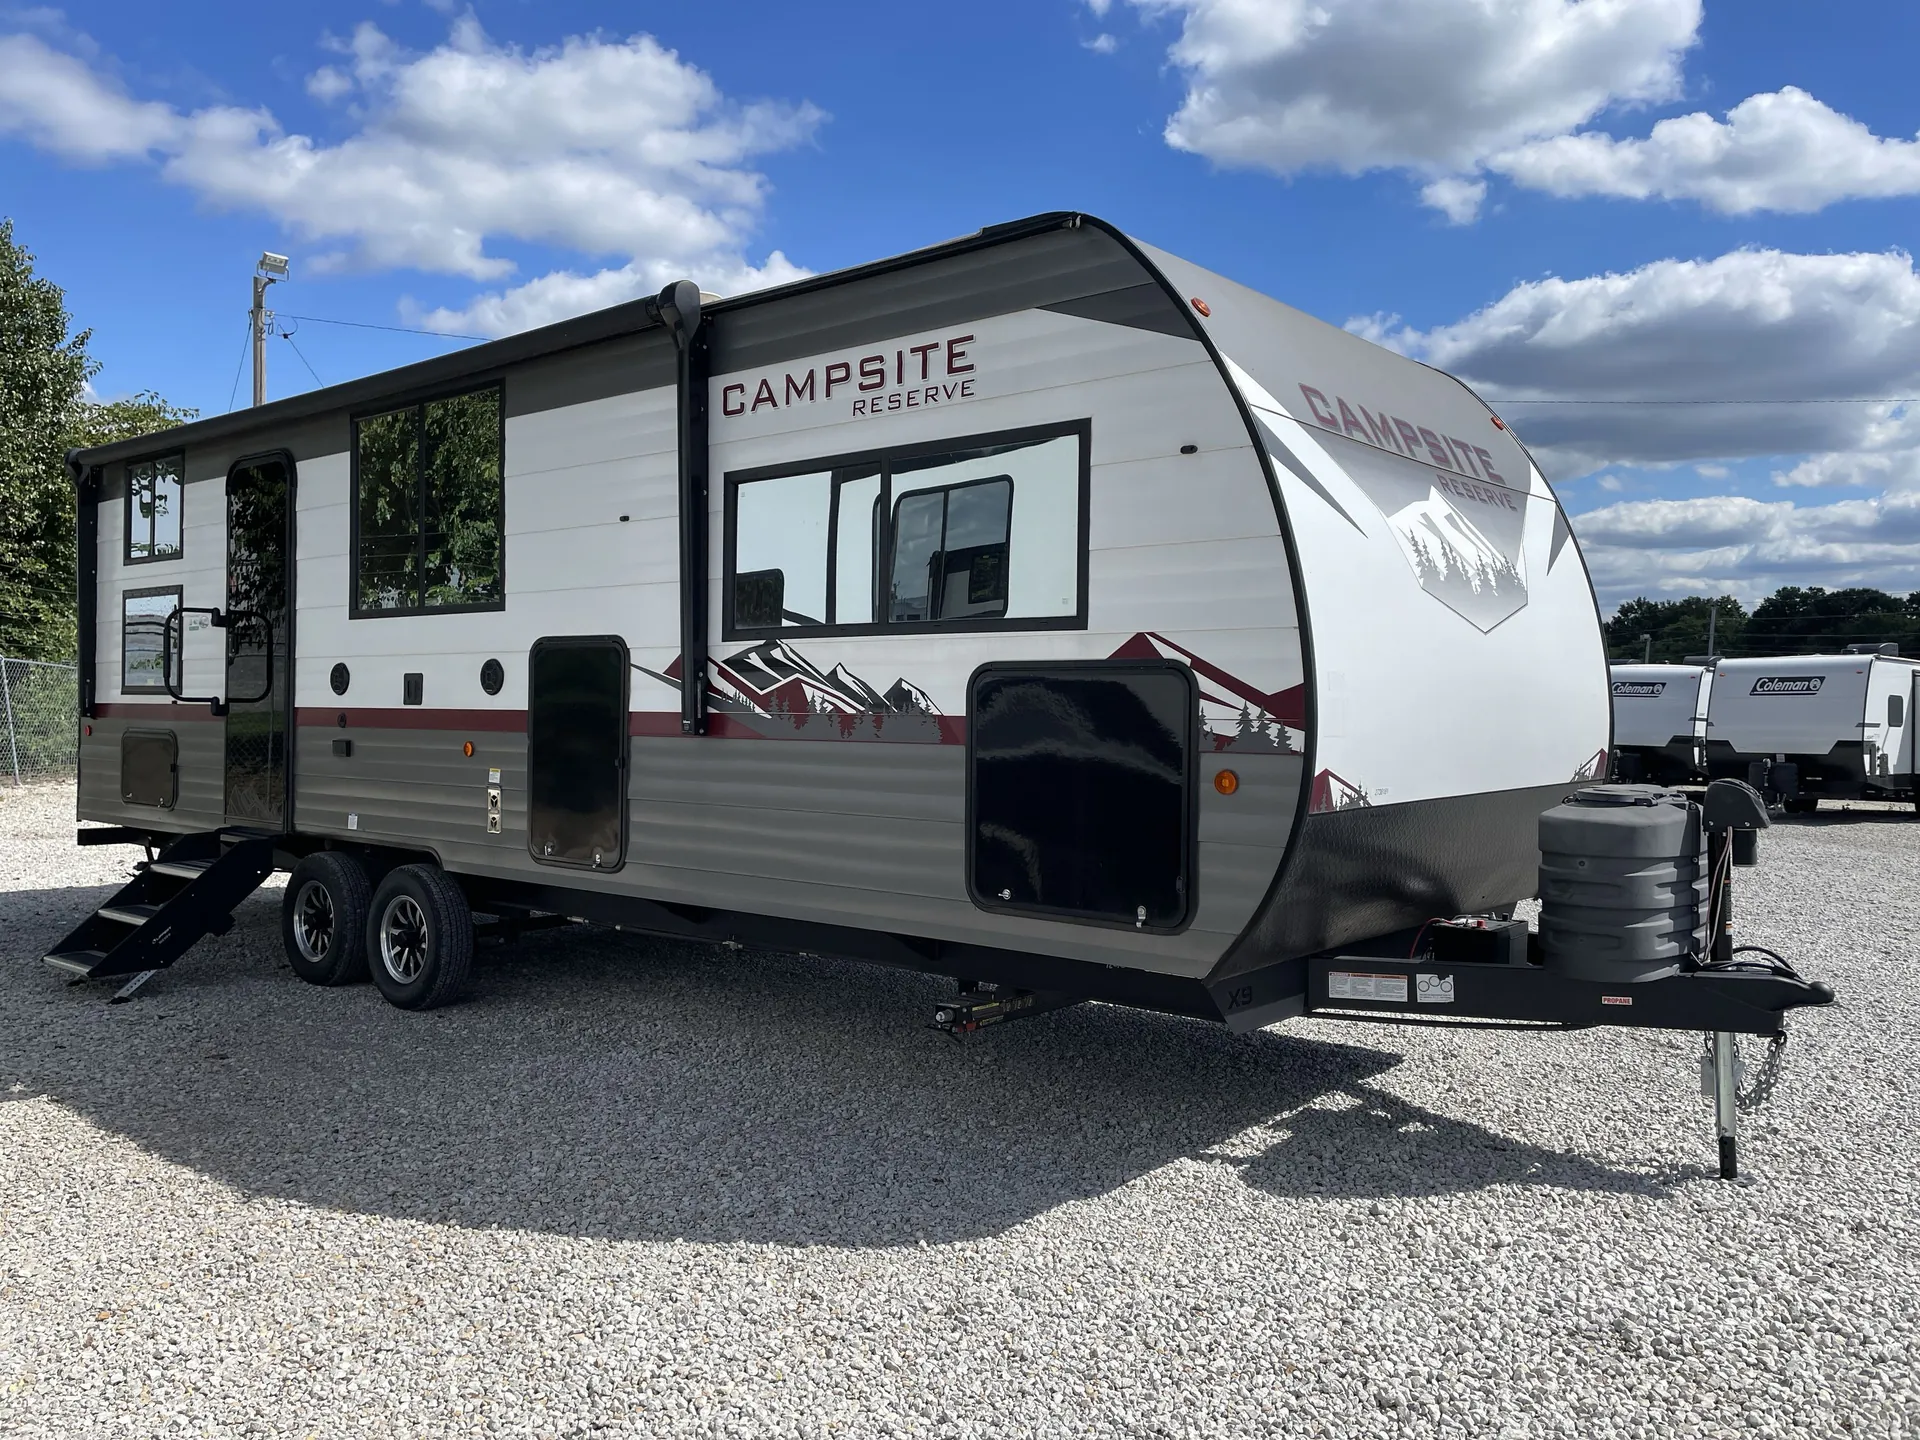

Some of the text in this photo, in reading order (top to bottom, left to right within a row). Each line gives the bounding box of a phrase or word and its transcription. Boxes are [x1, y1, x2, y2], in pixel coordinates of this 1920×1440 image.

[722, 334, 975, 417] CAMPSITE
[852, 379, 975, 417] RESERVE
[1298, 382, 1507, 486] CAMPSITE
[1436, 474, 1518, 512] RESERVE
[1612, 682, 1654, 694] Coleman
[1756, 678, 1809, 692] Coleman
[1227, 985, 1253, 1010] X9
[1603, 997, 1631, 1005] PROPANE
